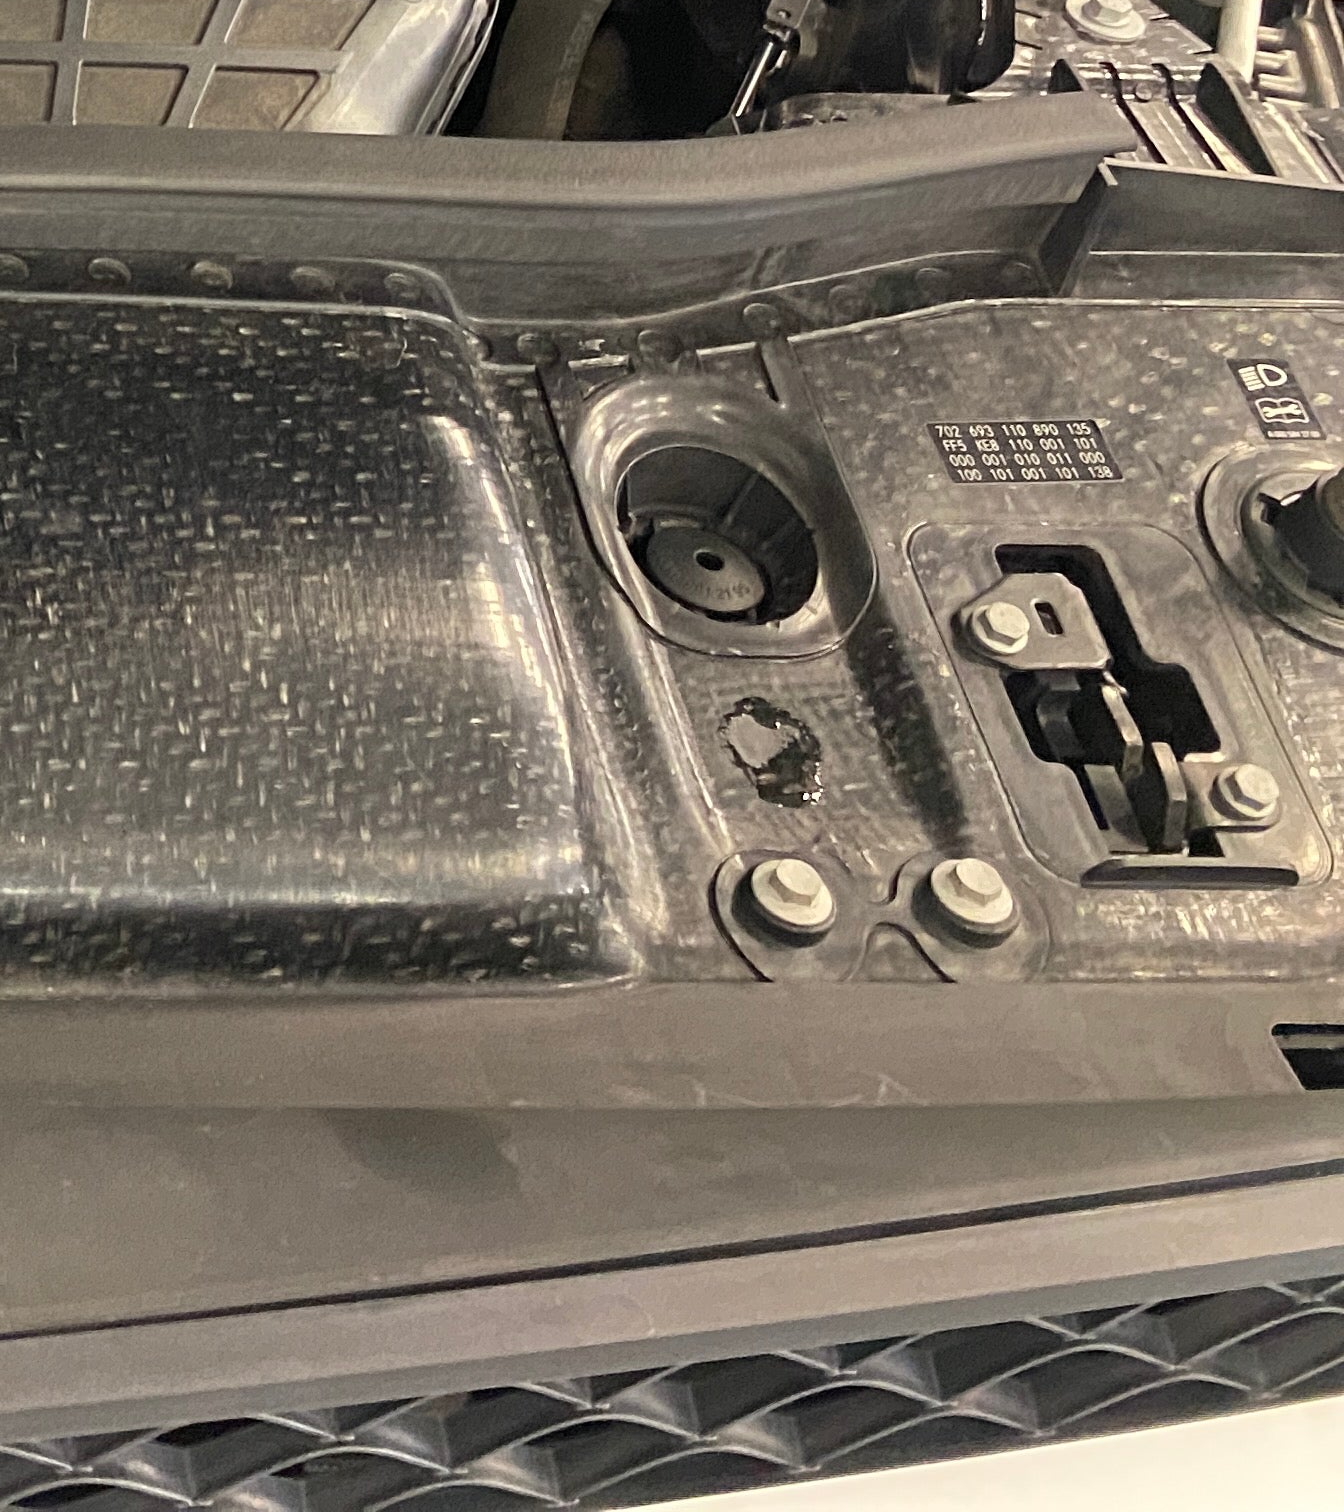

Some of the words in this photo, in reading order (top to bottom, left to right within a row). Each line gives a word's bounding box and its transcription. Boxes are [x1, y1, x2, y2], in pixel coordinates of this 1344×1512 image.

[935, 426, 962, 438] 702
[969, 425, 994, 437] 693
[1002, 425, 1026, 437] 110
[1033, 424, 1059, 435] 890
[1066, 423, 1091, 435] 135
[1009, 439, 1033, 450] 110
[1040, 439, 1065, 450] 001
[1074, 439, 1097, 449] 101
[949, 454, 975, 466] 000
[982, 454, 1007, 466] 001
[1014, 454, 1040, 465] 010
[1047, 454, 1072, 464] 011
[1079, 452, 1105, 464] 000
[957, 469, 982, 480] 100
[990, 469, 1014, 480] 101
[1021, 469, 1046, 480] 001
[1056, 468, 1079, 479] 101
